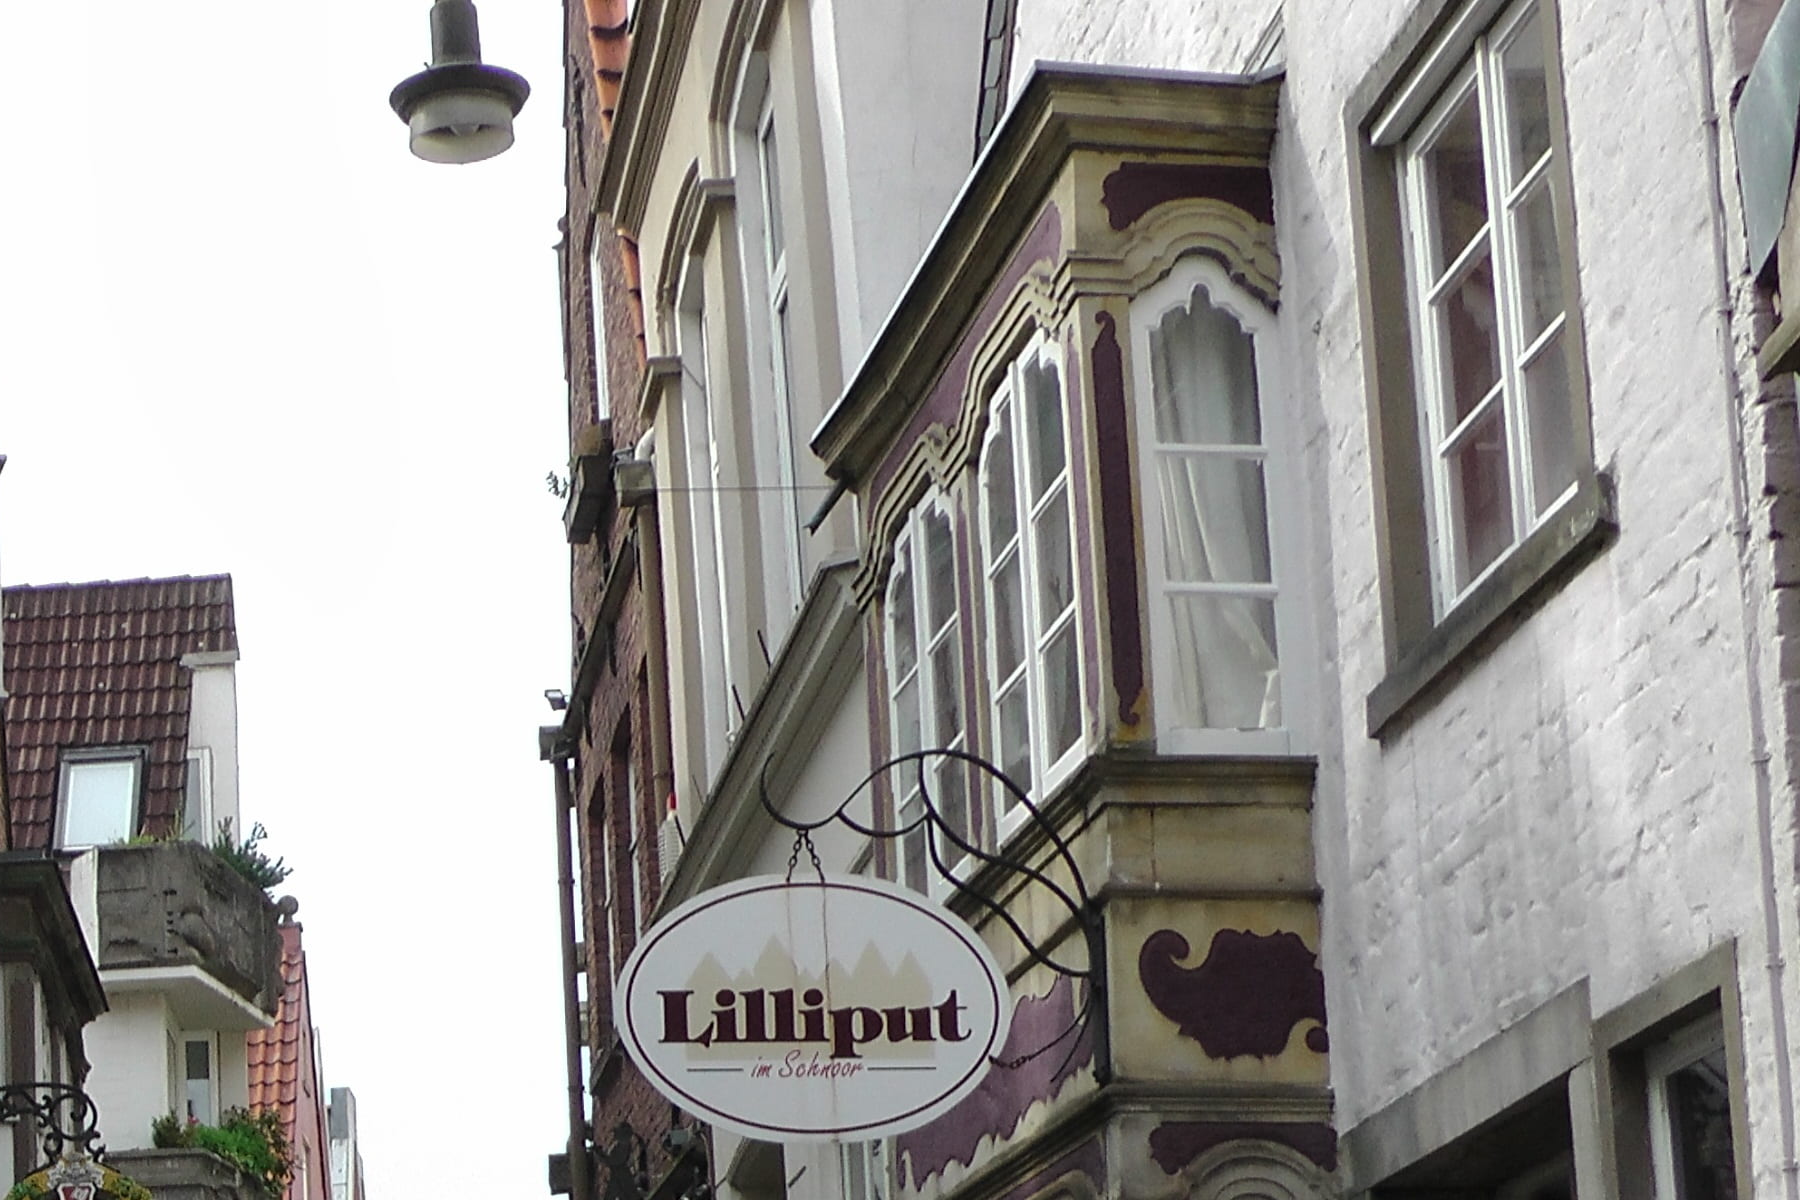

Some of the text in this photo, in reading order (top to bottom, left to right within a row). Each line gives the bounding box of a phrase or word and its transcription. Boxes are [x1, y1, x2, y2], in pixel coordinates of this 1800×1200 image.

[656, 988, 972, 1059] Lilliput
[750, 1049, 865, 1080] im Schnoor
